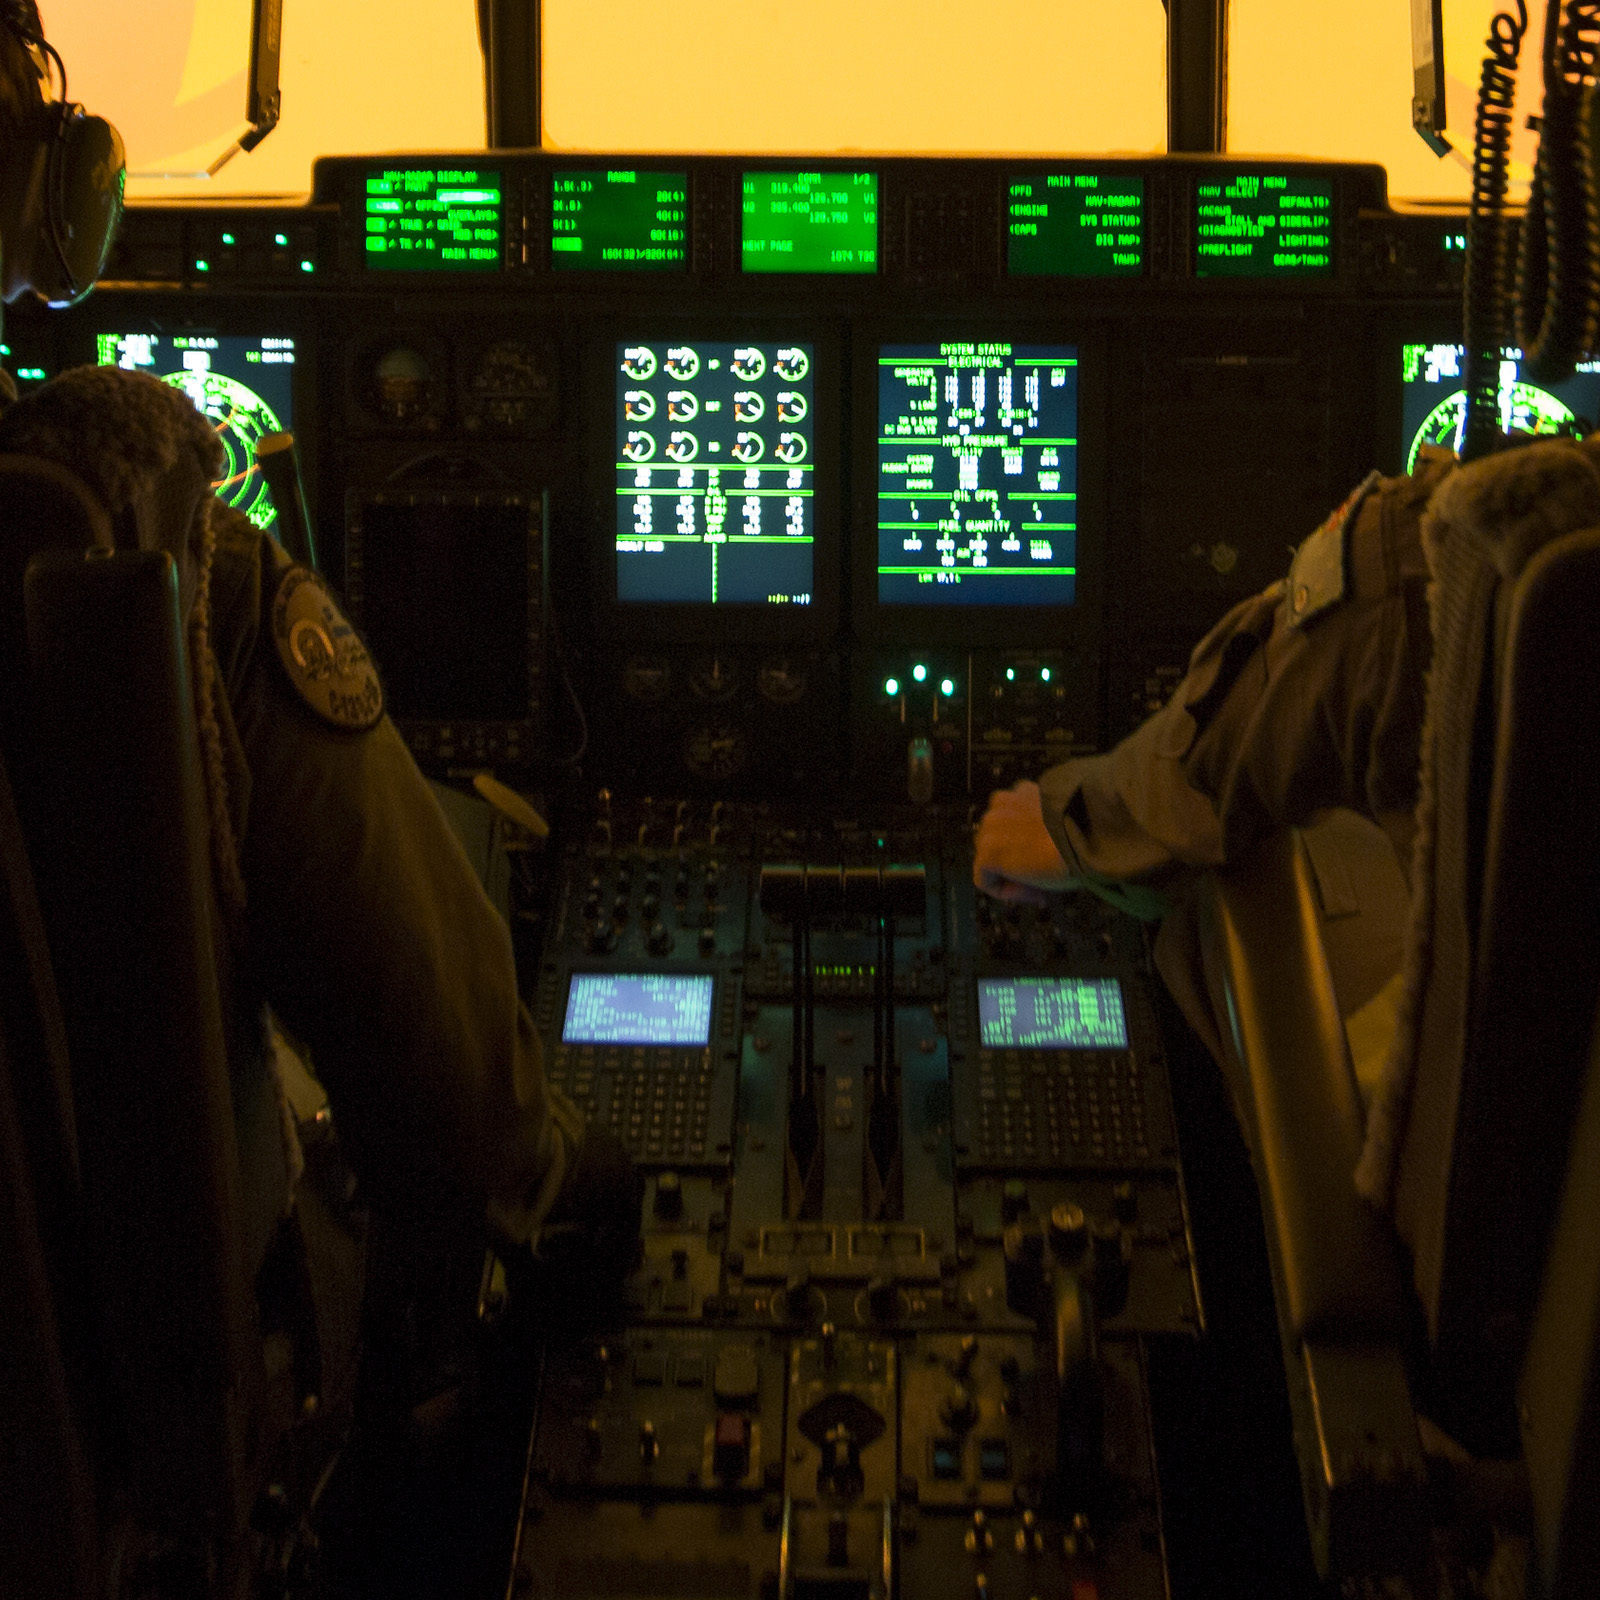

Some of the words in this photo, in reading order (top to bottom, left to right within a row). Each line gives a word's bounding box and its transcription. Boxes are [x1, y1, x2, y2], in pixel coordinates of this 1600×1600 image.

[1047, 175, 1071, 188] MAIN
[1074, 175, 1098, 188] MENU
[1236, 176, 1260, 188] MAIN
[1263, 176, 1287, 189] MENU
[742, 239, 766, 252] NEXT
[770, 239, 793, 252] PAGE
[940, 343, 975, 356] SYSTEM
[977, 343, 1012, 356] STATUS
[948, 355, 1004, 368] ELECTRICAL
[953, 489, 971, 502] OIL
[938, 519, 962, 532] FUEL
[965, 519, 1011, 532] QUANTITY
